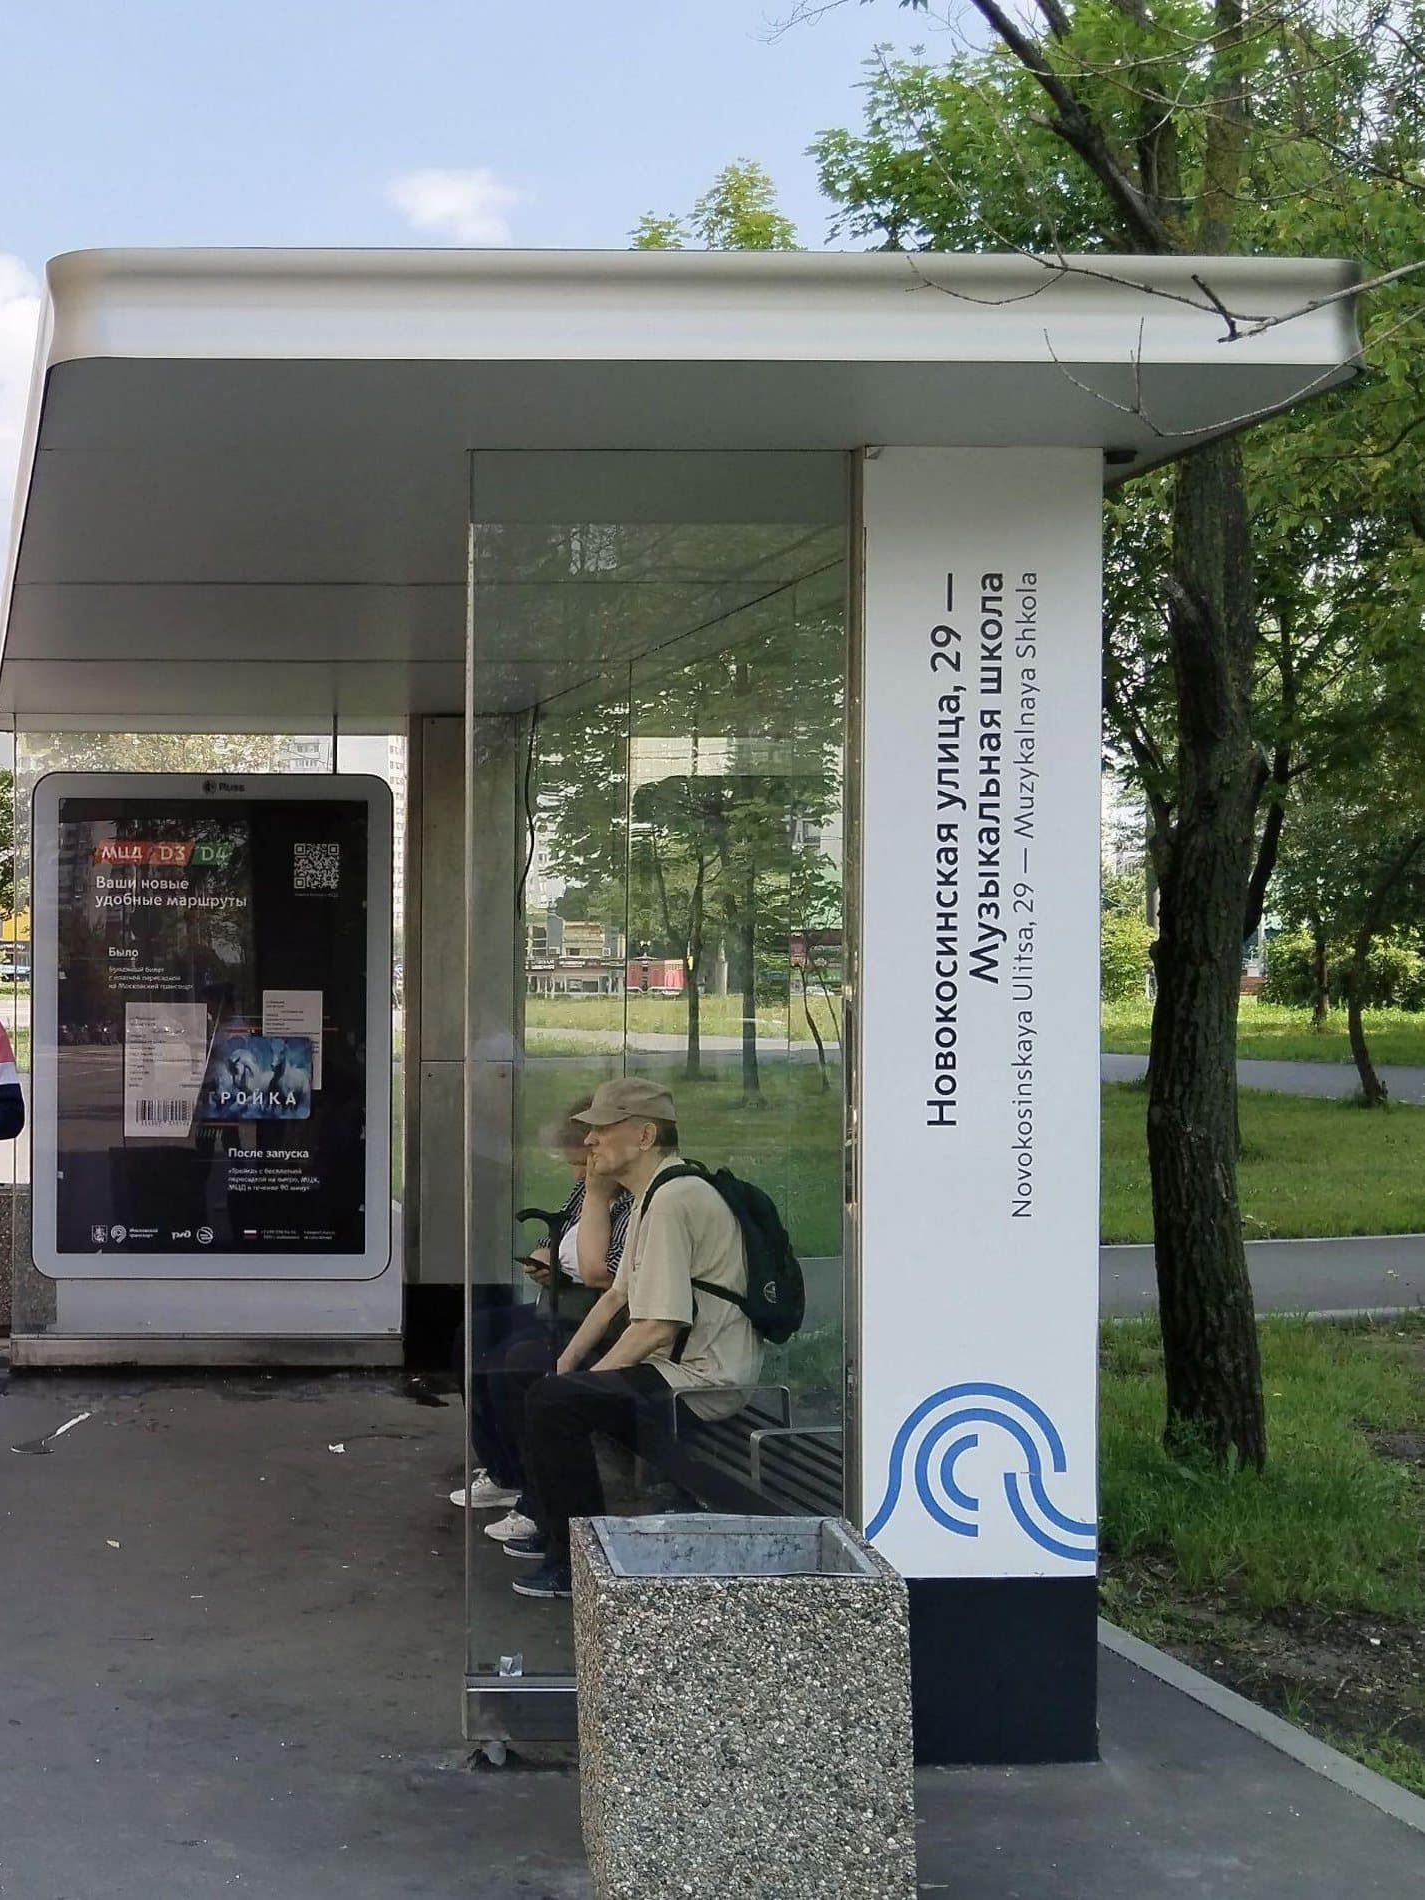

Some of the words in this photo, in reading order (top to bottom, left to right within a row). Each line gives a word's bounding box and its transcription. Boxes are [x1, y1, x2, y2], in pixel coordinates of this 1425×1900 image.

[930, 624, 962, 673] 29
[980, 572, 1004, 695] школа
[1013, 570, 1039, 659] Shkola
[935, 685, 967, 812] улица,
[1012, 668, 1041, 840] Muzykalnaya
[96, 876, 137, 889] Ваши
[141, 879, 190, 890] новые
[101, 845, 143, 862] МЦД
[160, 845, 185, 861] D3
[201, 845, 229, 861] D4
[969, 709, 1007, 985] Музыкальная
[95, 893, 163, 908] удобные
[166, 896, 247, 910] маршруты
[1012, 882, 1035, 913] 29
[108, 946, 139, 957] Было
[926, 823, 959, 1126] Новокосинская
[1012, 921, 1039, 1001] Ulitsa,
[228, 1147, 264, 1158] После
[265, 1150, 310, 1161] запуска
[1011, 1010, 1038, 1218] Novokosinskaya
